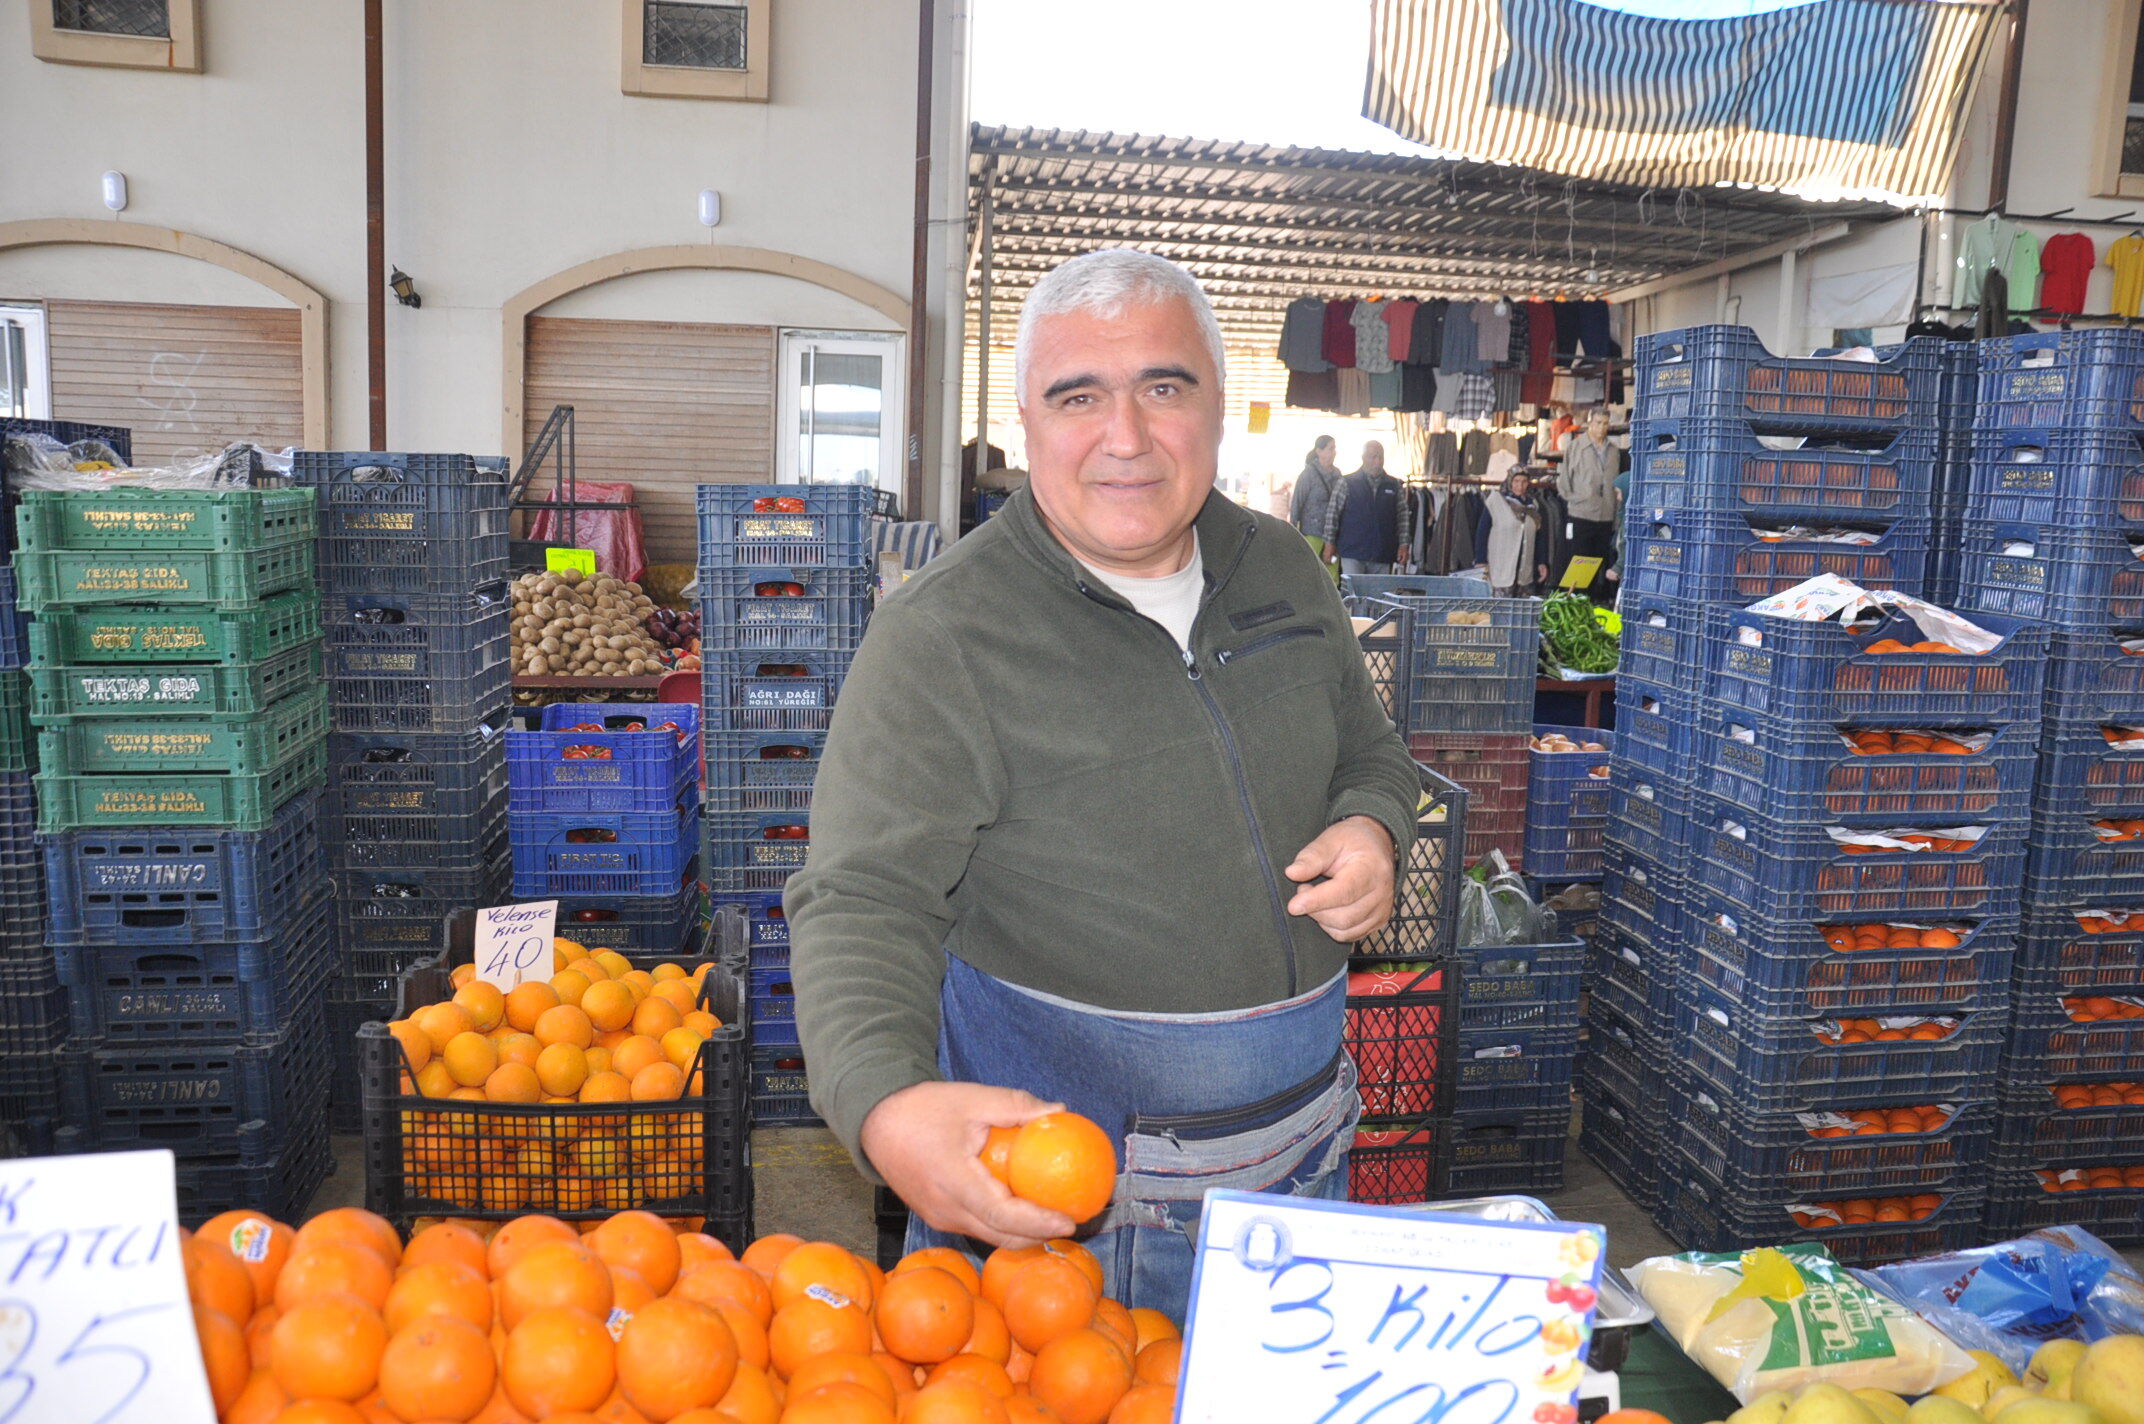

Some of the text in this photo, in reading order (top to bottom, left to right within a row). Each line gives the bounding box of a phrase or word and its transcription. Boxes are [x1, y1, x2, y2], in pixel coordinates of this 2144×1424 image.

[81, 677, 201, 694] TEKTAS GIDA
[89, 692, 111, 701] HAL
[748, 689, 816, 699] AĞRI DAĞI
[561, 853, 597, 862] FIRAT
[142, 863, 206, 886] CANLI
[488, 905, 552, 924] Velense
[484, 936, 543, 977] 40
[1469, 980, 1535, 992] SEDO BABA
[1463, 1065, 1493, 1076] SEDO
[1455, 1143, 1521, 1156] SEDO BABA
[1260, 1258, 1544, 1356] 3 Kilo
